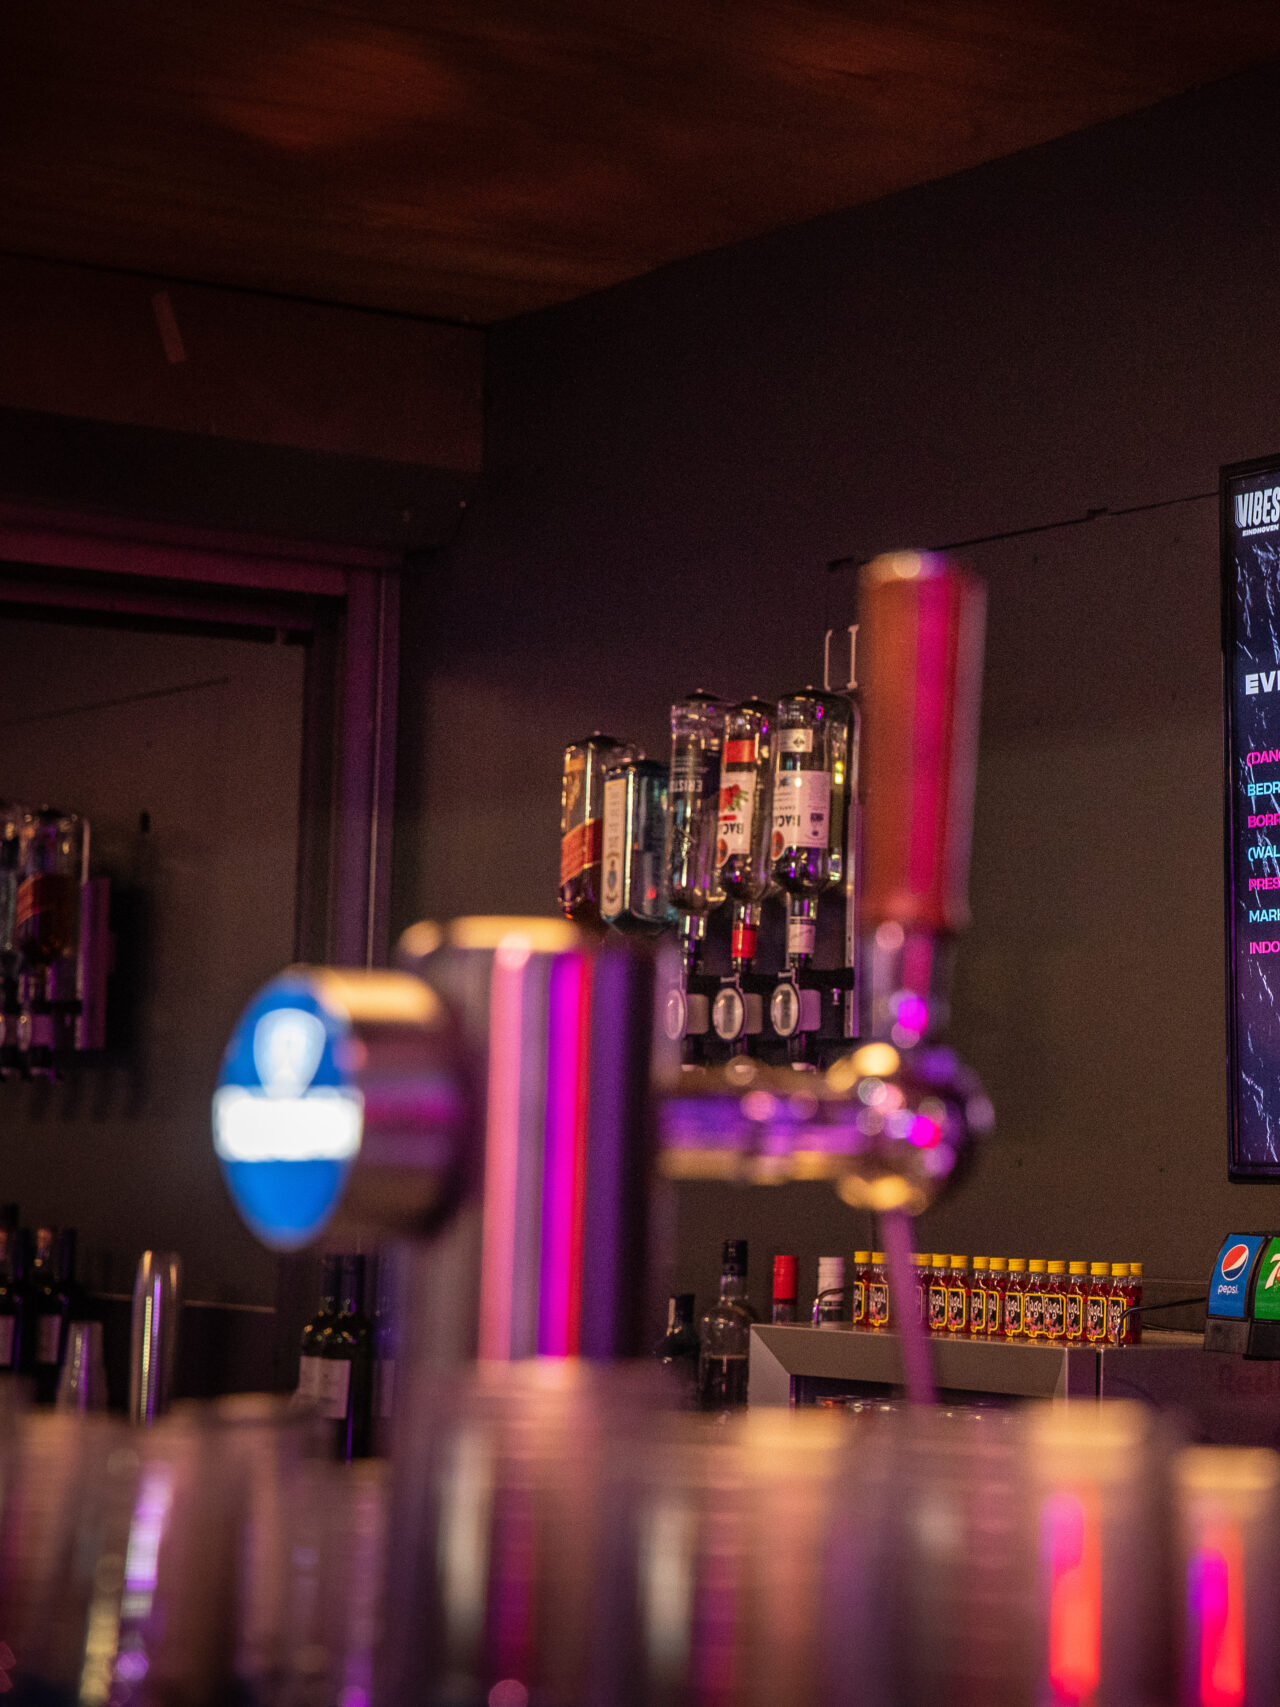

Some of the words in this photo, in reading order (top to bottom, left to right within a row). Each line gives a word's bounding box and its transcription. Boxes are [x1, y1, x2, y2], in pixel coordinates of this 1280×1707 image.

[1235, 486, 1280, 528] VIBES
[1242, 524, 1279, 537] EINDHOVEN
[1217, 1284, 1239, 1296] pepsi
